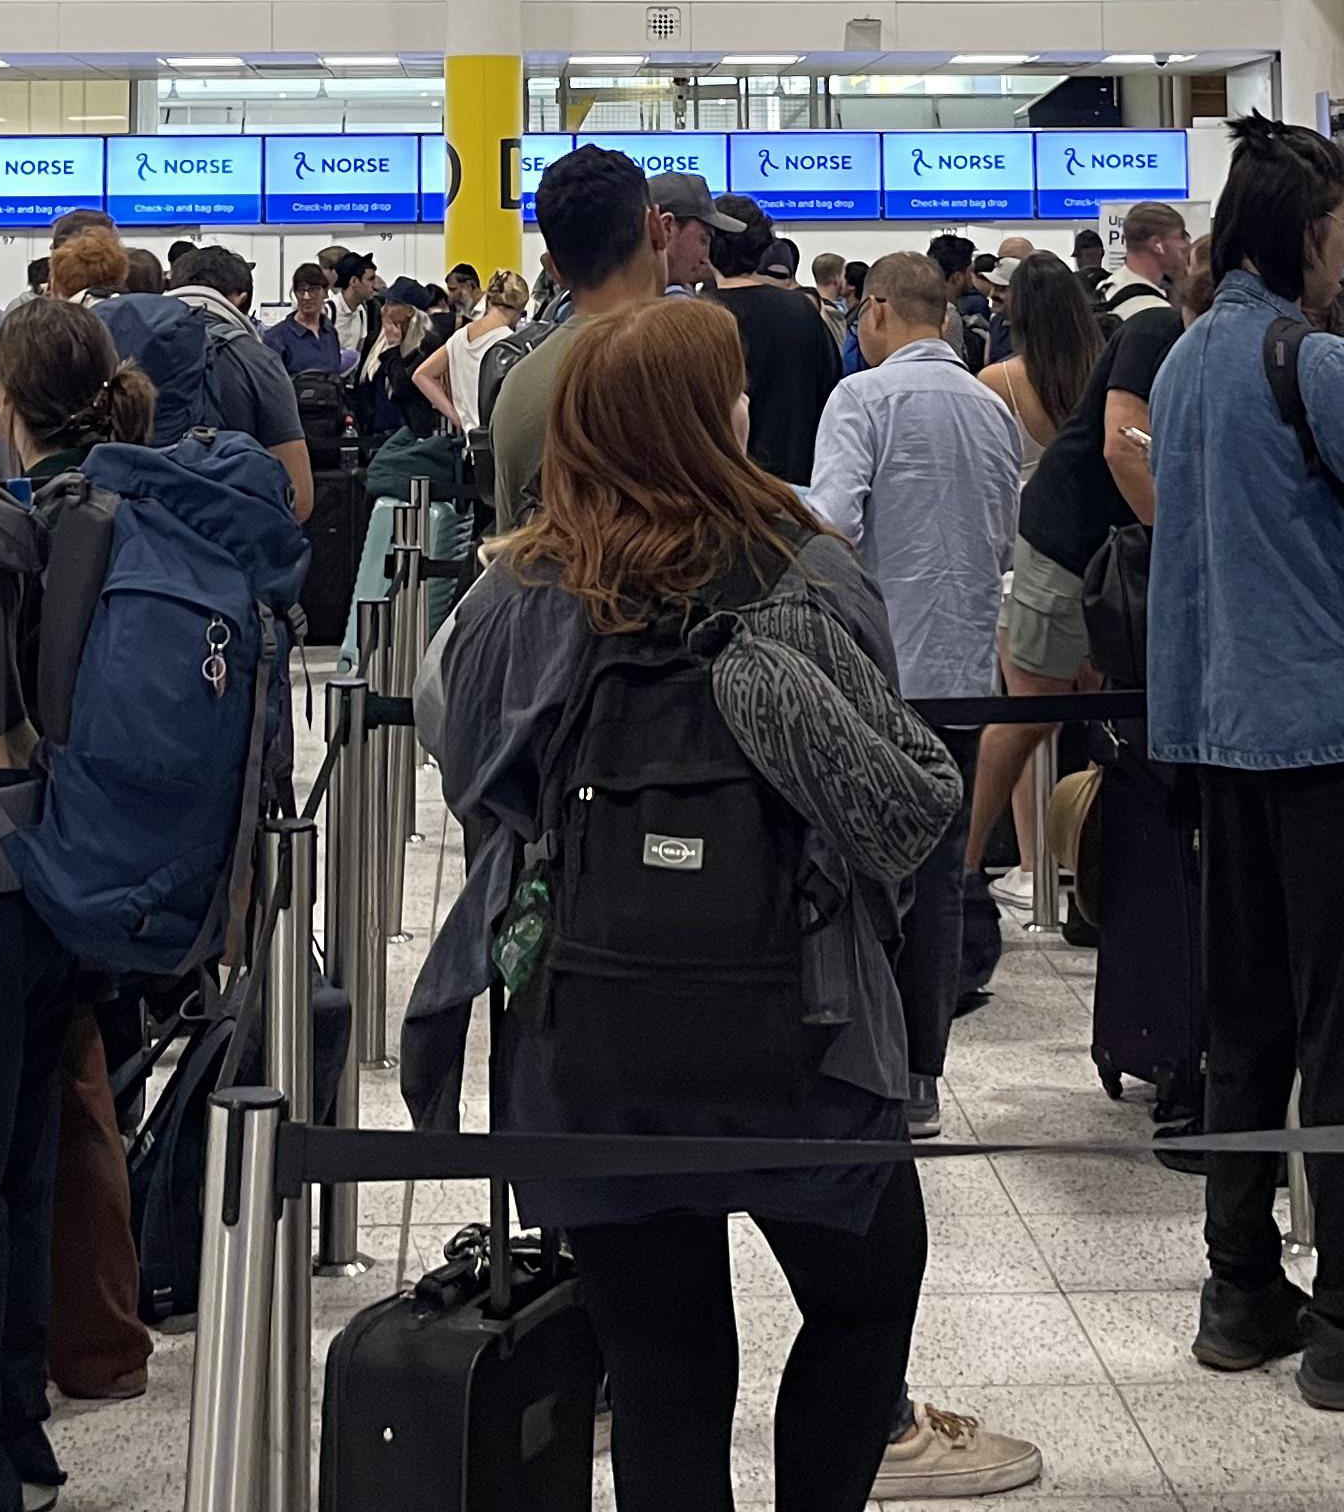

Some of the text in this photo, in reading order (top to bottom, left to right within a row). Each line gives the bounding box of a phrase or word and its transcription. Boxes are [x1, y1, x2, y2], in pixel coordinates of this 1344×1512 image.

[5, 160, 75, 176] NORSE
[164, 159, 234, 175] NORSE
[322, 158, 390, 174] NORSE
[785, 155, 853, 170] NORSE
[939, 155, 1006, 170] NORSE
[1091, 154, 1159, 169] NORSE
[134, 204, 234, 215] Check-in and bag drop
[292, 202, 392, 213] Check-in and bag drop
[758, 199, 855, 210] Check-in and bag drop
[910, 198, 1008, 209] Check-in and bag drop
[17, 206, 33, 214] and
[35, 206, 53, 216] bag
[380, 232, 393, 242] 99
